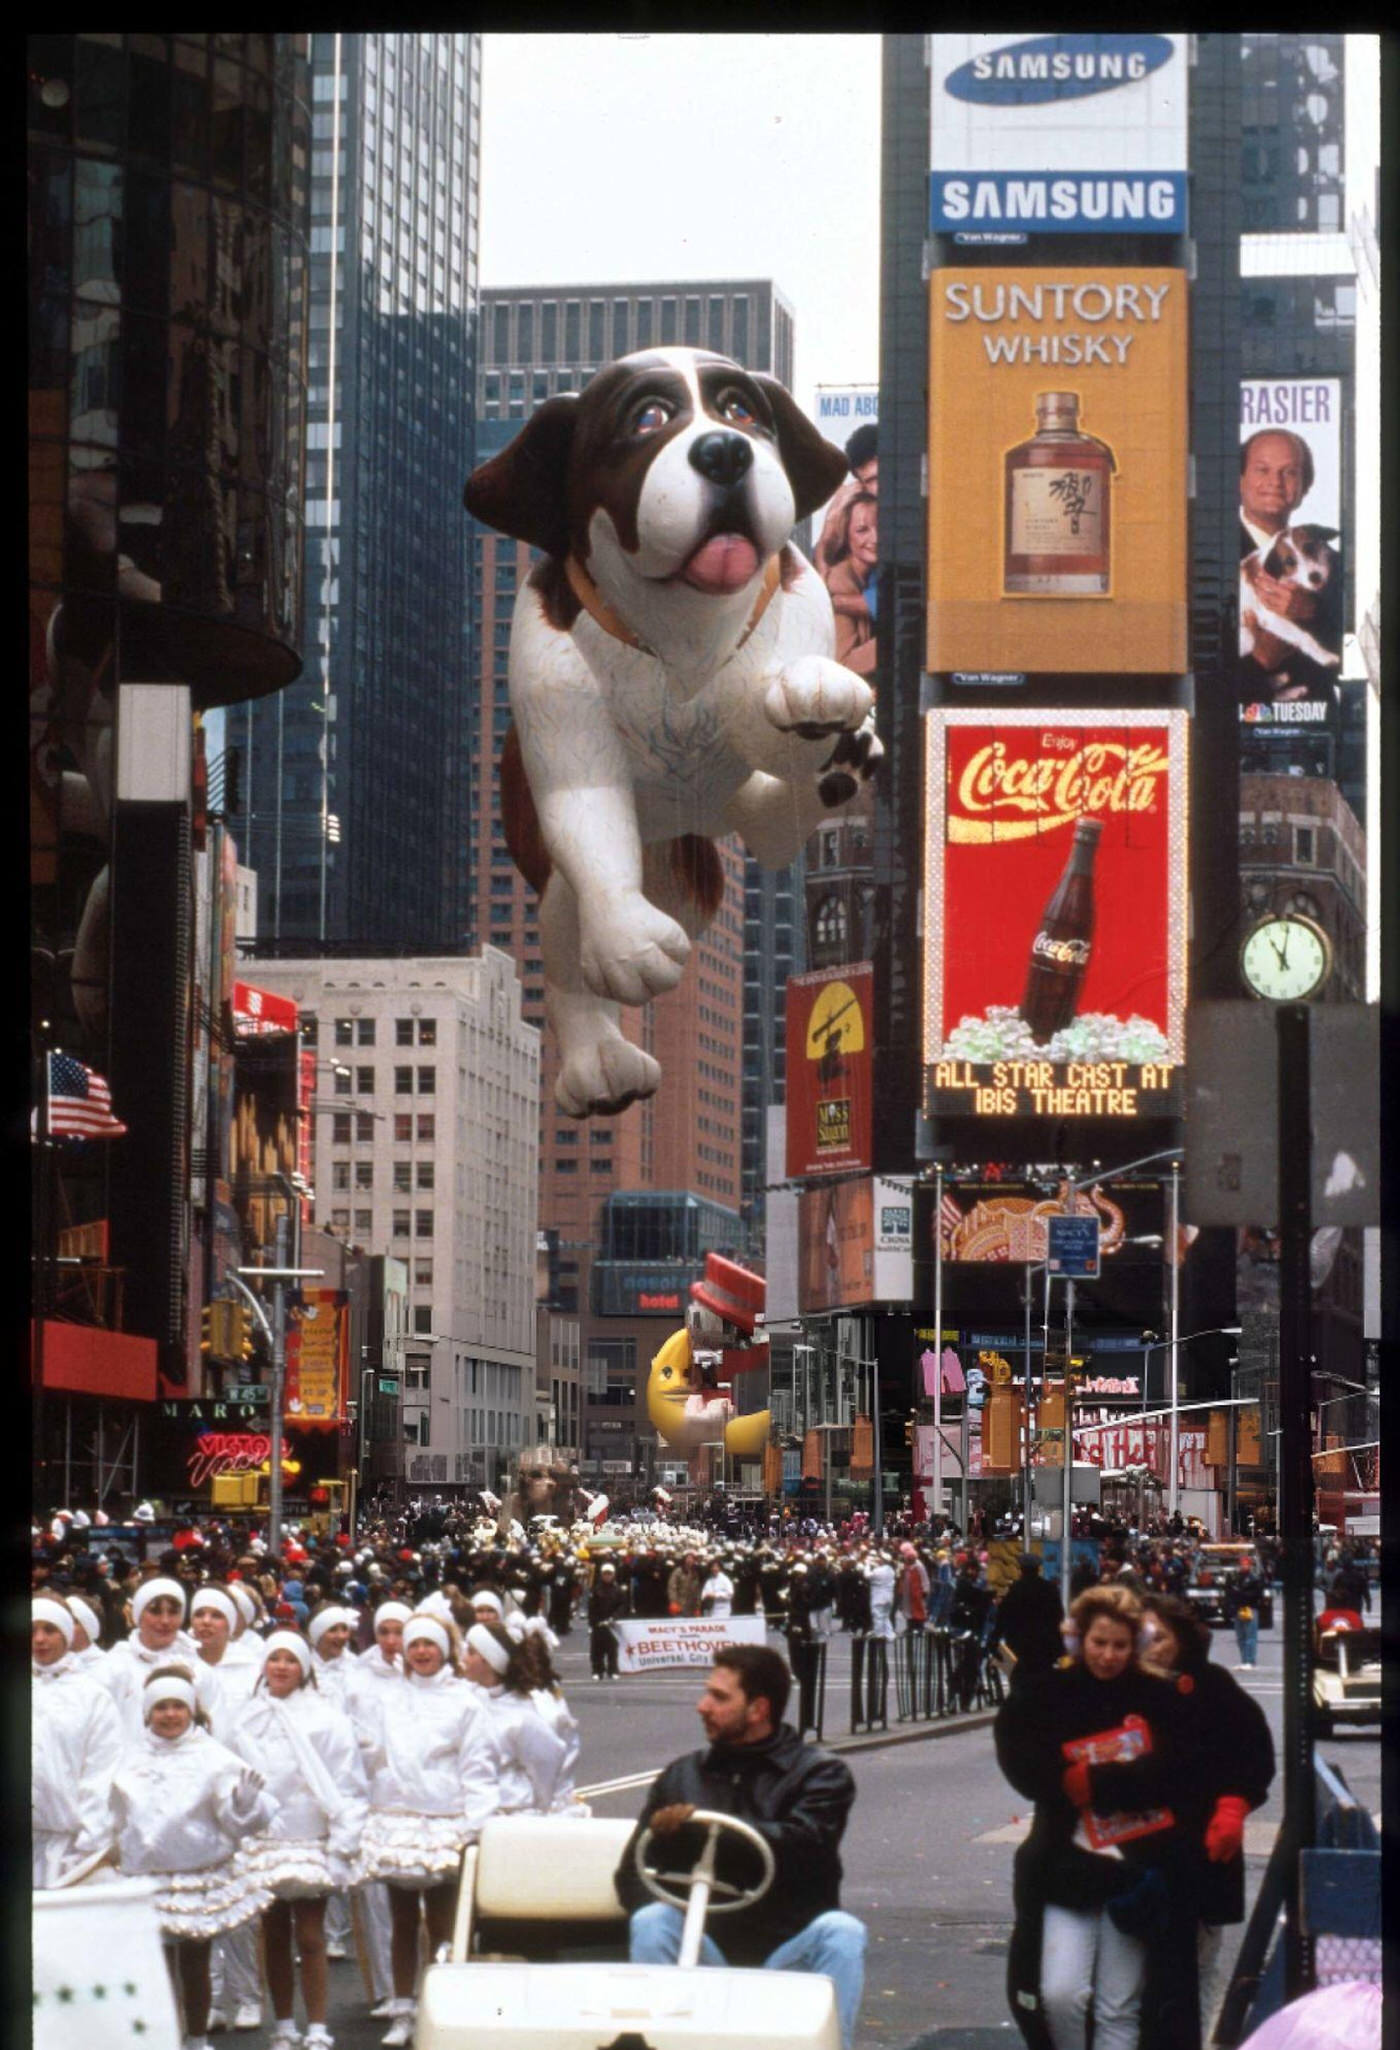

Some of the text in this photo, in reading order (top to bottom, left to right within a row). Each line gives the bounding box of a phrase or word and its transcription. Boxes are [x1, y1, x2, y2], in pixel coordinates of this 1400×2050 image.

[973, 53, 1147, 80] SAMSUNG
[942, 181, 1175, 220] SAMSUNG
[944, 283, 1171, 323] SUNTORY
[983, 334, 1134, 366] WHISKY
[820, 397, 849, 416] MAD
[959, 673, 1019, 685] Van Wagner
[1272, 702, 1327, 721] TUESDAY
[1042, 733, 1077, 750] Enjoy
[959, 742, 1166, 812] Coca-Cola
[935, 1063, 1174, 1088] ALL STAR CAST AT
[975, 1088, 1137, 1115] IBIS THEATRE
[689, 1625, 727, 1633] PARADE
[637, 1640, 747, 1655] BEETHOVE
[640, 1654, 684, 1666] Universal
